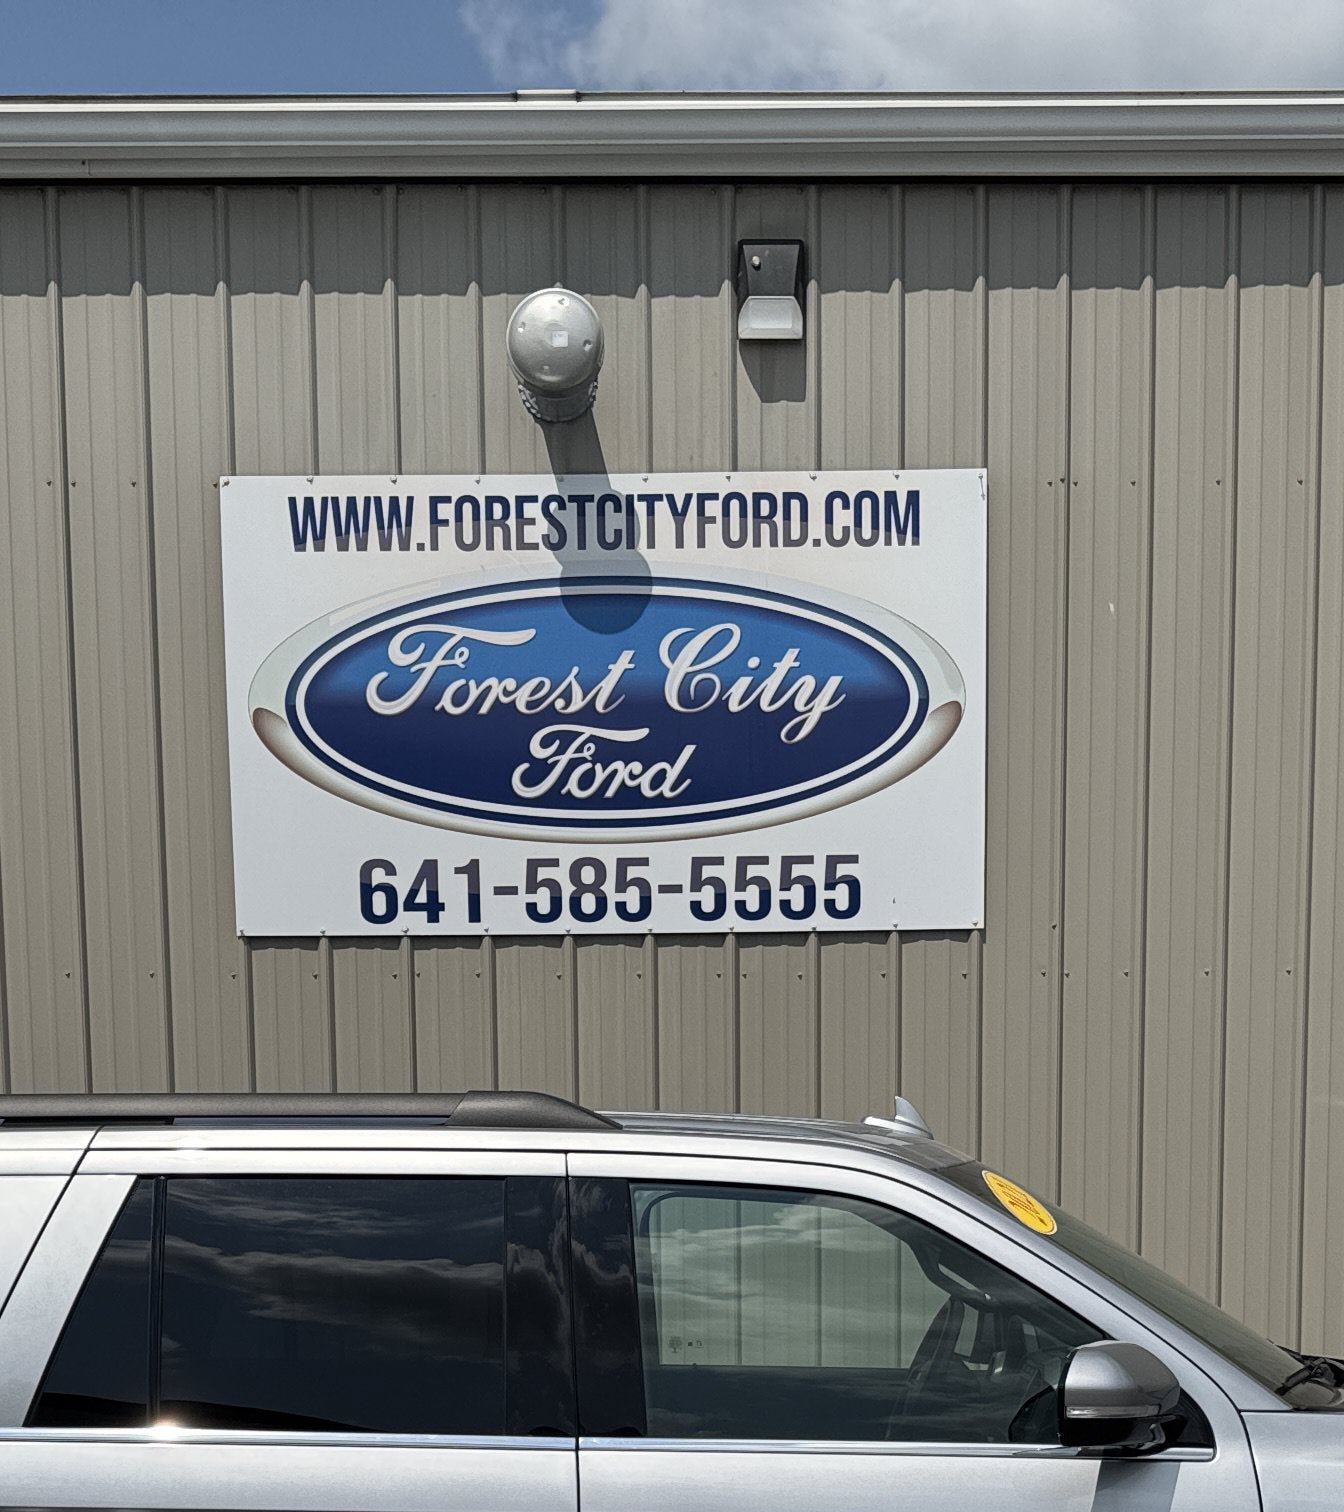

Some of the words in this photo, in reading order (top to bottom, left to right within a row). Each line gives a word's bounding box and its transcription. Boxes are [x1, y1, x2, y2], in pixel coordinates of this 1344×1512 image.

[287, 489, 921, 553] WWW.FORESTCITYFORD.COM
[364, 622, 636, 716] Forest
[657, 621, 847, 744] City
[510, 723, 698, 799] Ford
[358, 854, 862, 925] 641-585-5555
